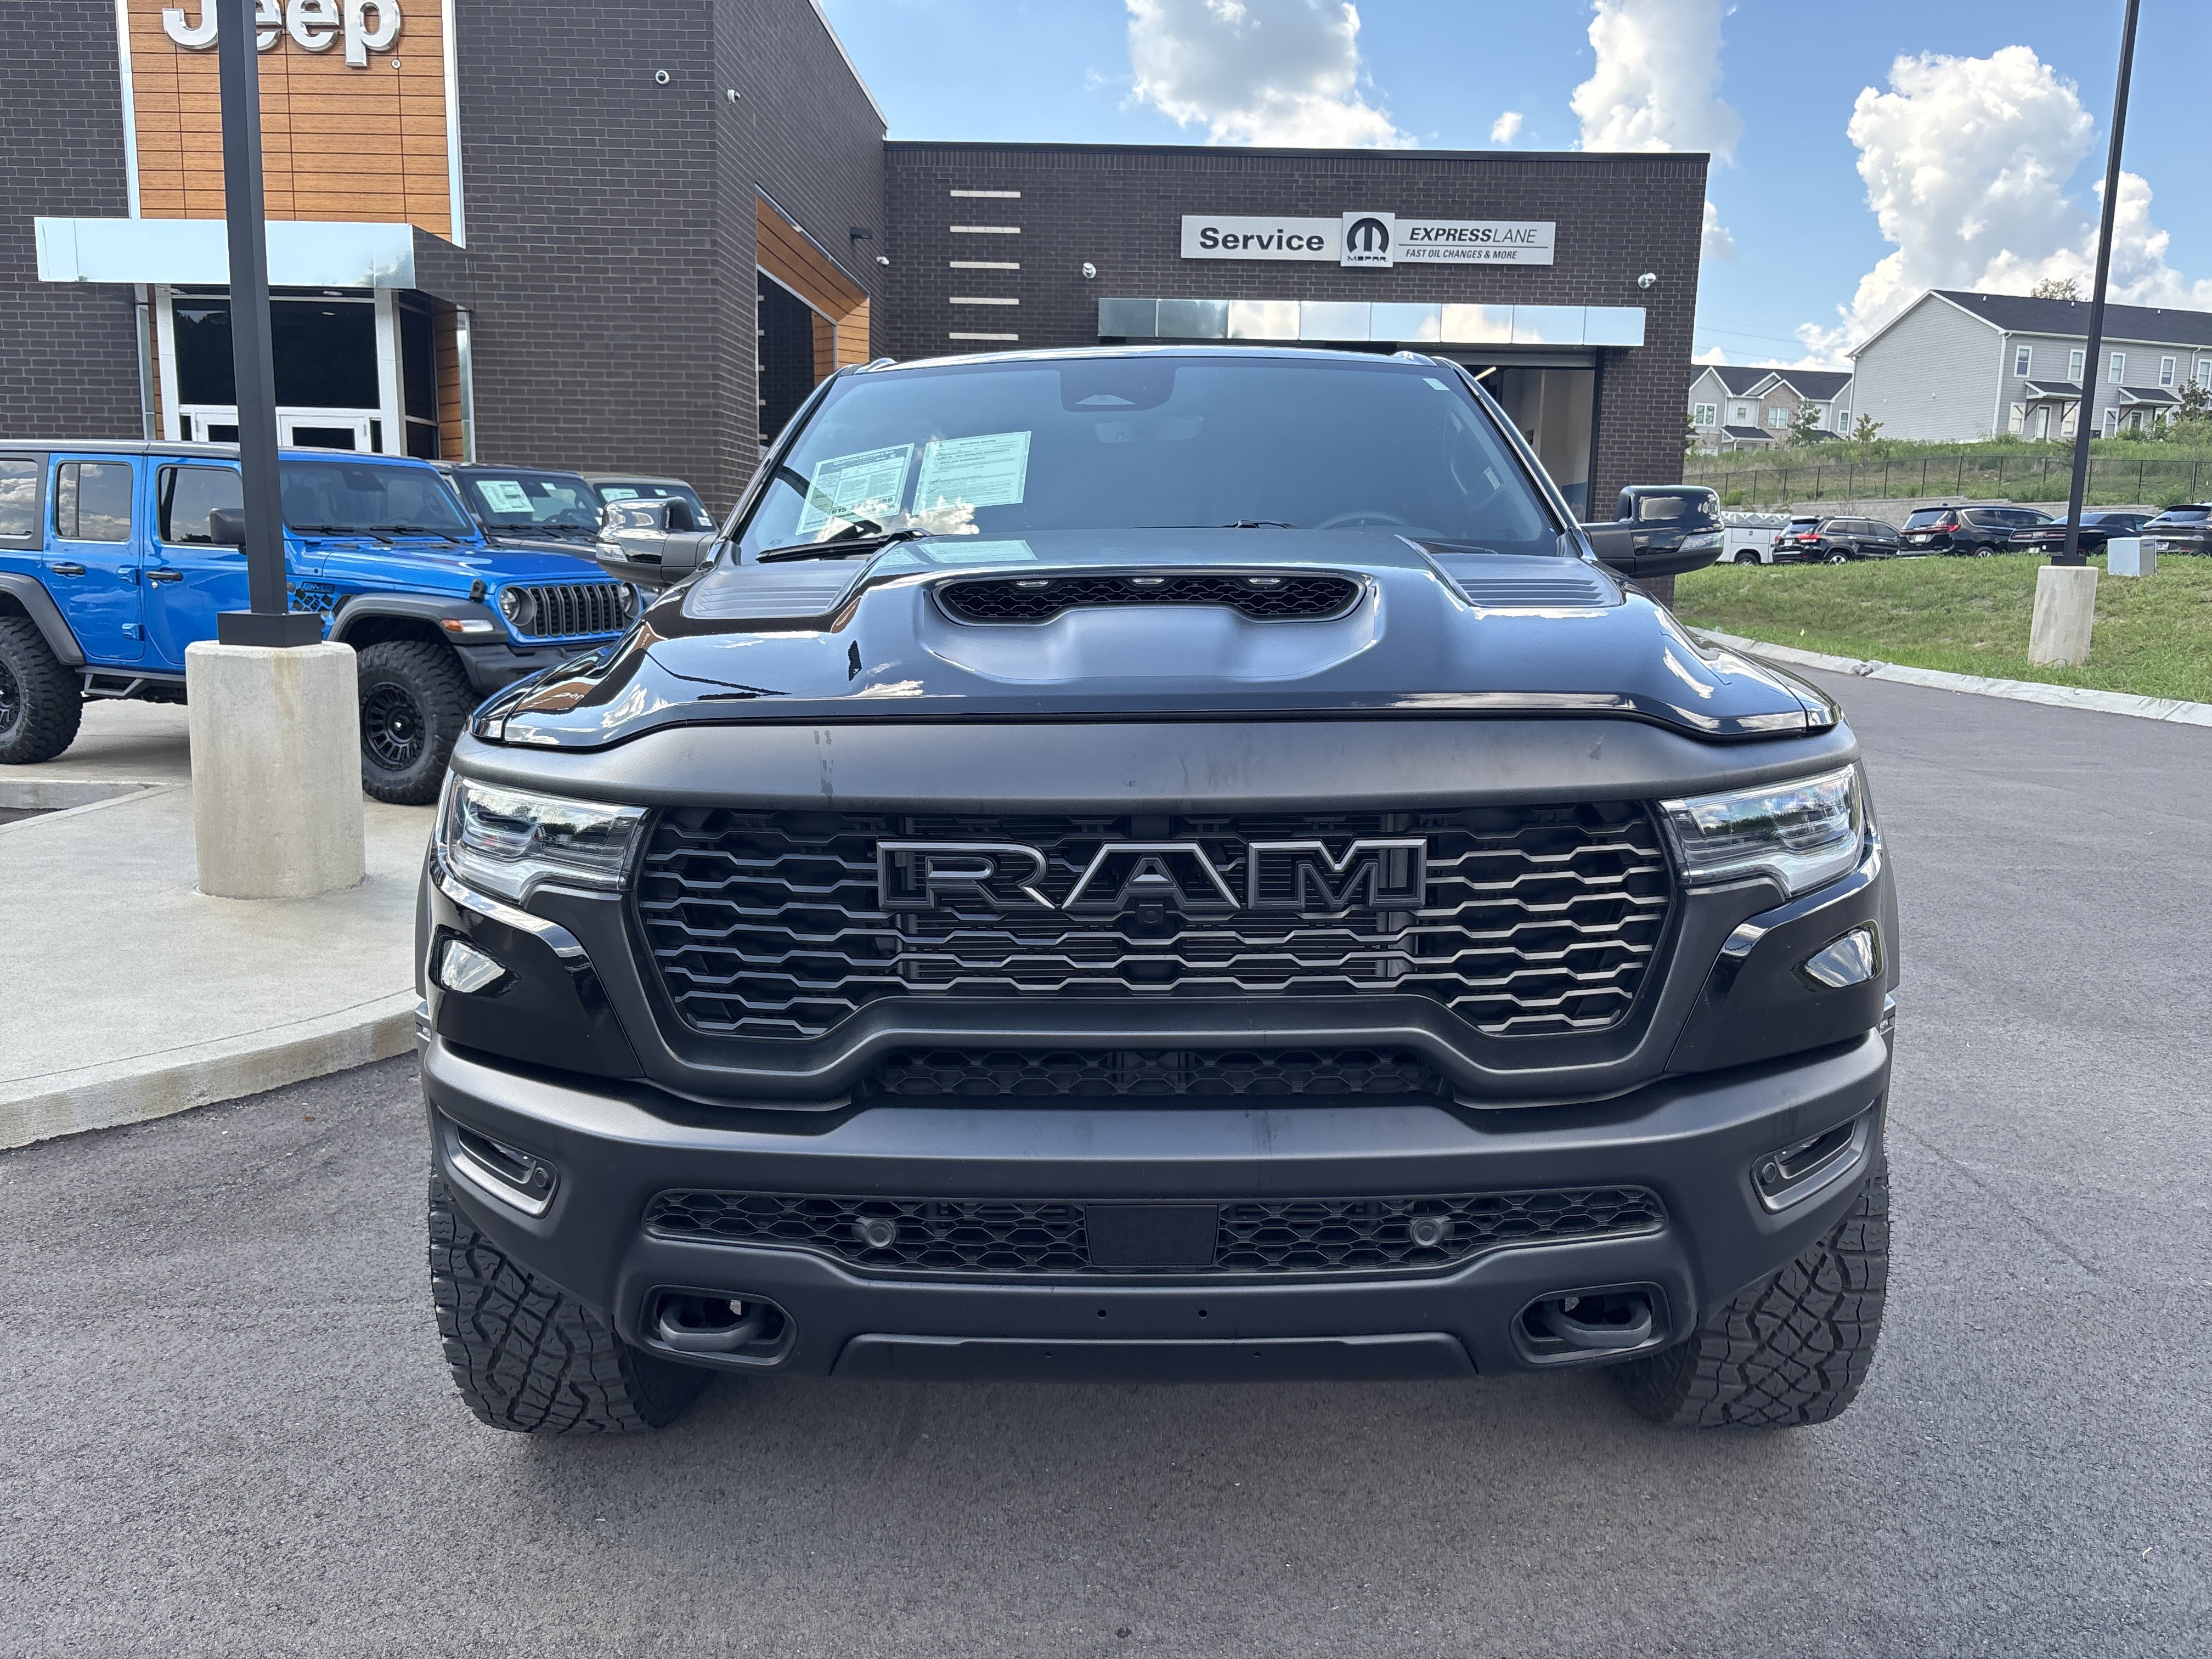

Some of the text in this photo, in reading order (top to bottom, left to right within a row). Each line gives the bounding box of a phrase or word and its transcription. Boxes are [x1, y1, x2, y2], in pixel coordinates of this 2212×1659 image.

[1199, 227, 1324, 251] Service
[1409, 228, 1537, 243] EXPRESSLANE
[1406, 249, 1517, 259] FAST OIL CHANGES & MORE
[877, 840, 1427, 910] RAM
